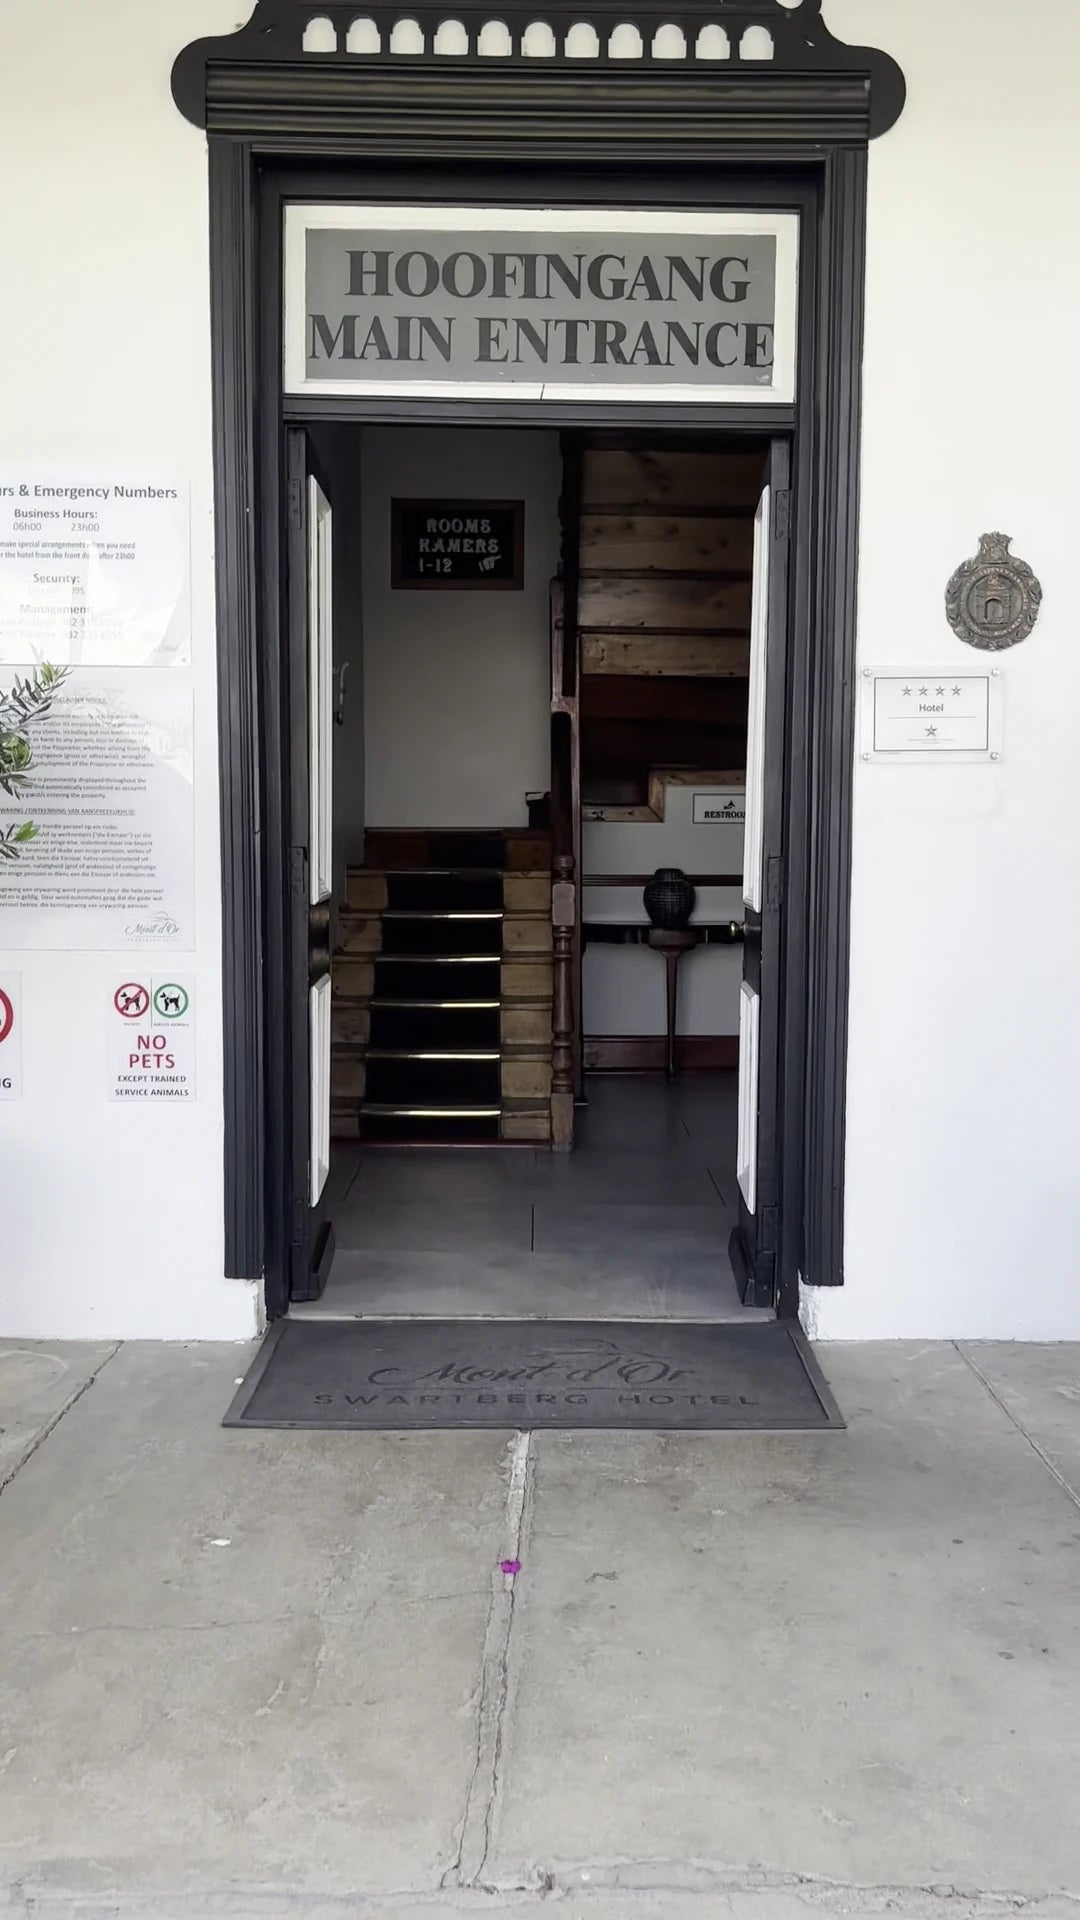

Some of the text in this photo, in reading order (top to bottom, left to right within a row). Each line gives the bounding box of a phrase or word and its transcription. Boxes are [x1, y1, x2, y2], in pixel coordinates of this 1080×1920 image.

[345, 250, 751, 303] HOOFINGANG
[308, 313, 775, 368] MAIN ENTRANCE
[19, 484, 30, 497] &
[34, 485, 110, 500] Emergency
[114, 486, 178, 499] Numbers
[14, 508, 98, 519] Business Hours:
[13, 522, 100, 532] 06h00 23h00
[427, 518, 492, 533] ROOMS
[420, 538, 499, 553] KAMERS
[420, 558, 453, 573] 1-12
[33, 573, 81, 584] Security:
[919, 704, 945, 713] Hotel
[704, 811, 746, 819] RESTROO
[137, 1034, 167, 1050] NO
[129, 1053, 176, 1069] PETS
[0, 1078, 12, 1089] G
[118, 1075, 187, 1083] EXCEPT TRAINED
[115, 1088, 189, 1097] SERVICE ANIMALS
[314, 1393, 759, 1405] SWARTBERG HOTEL
